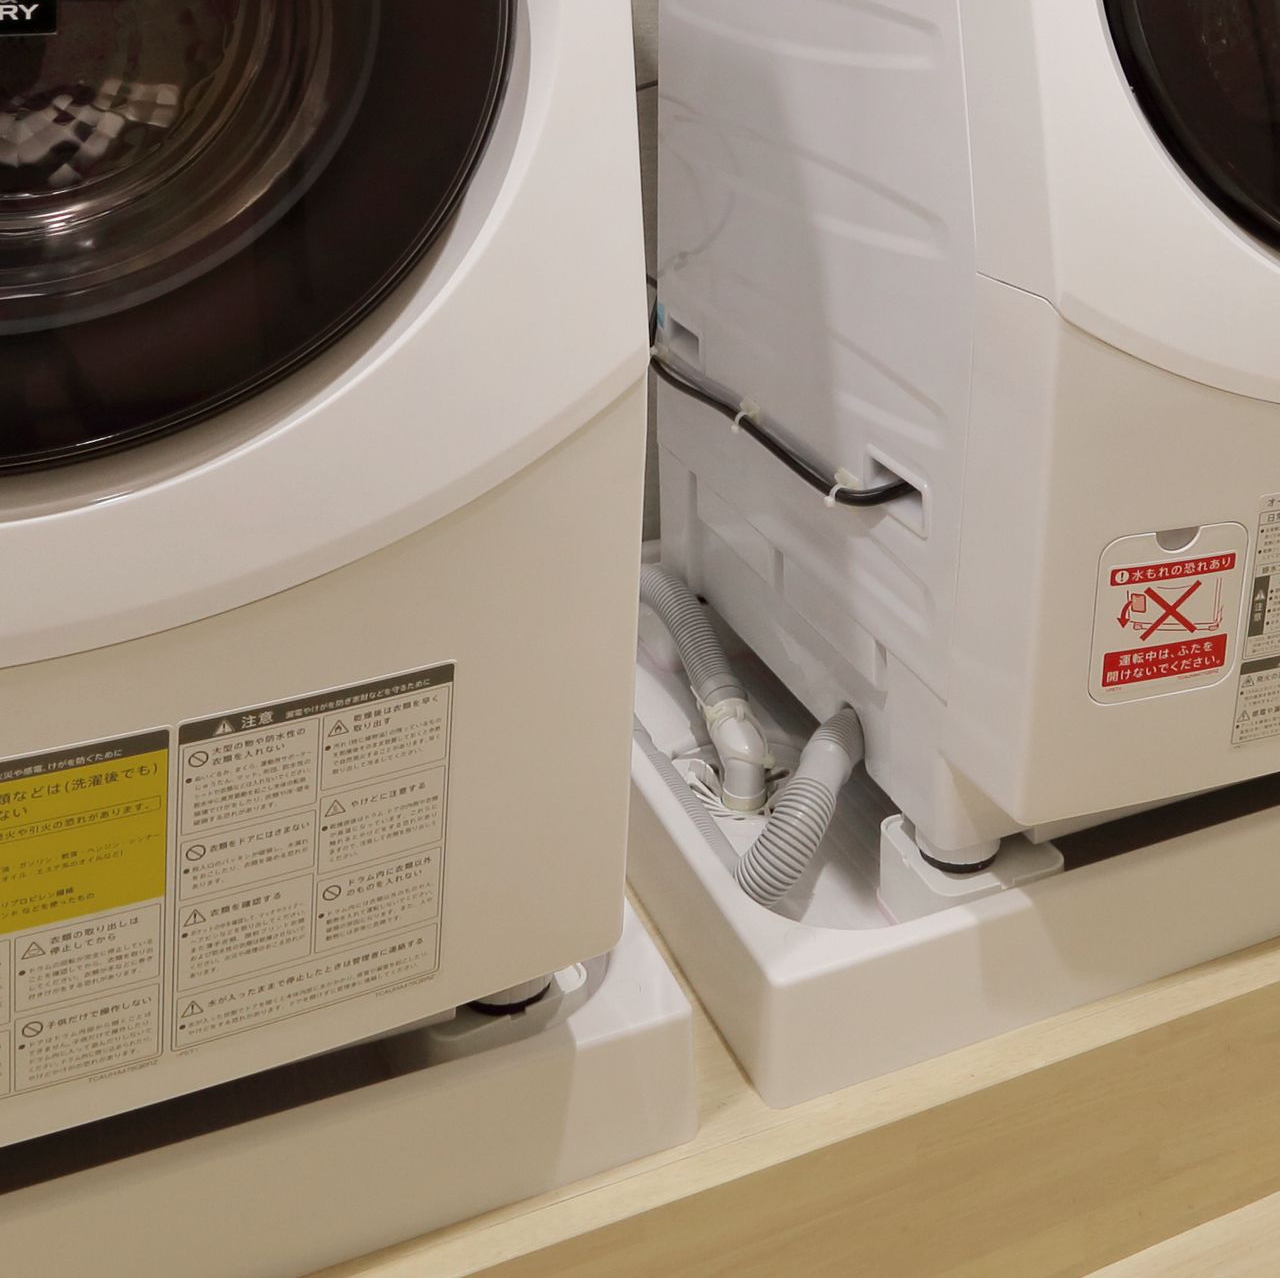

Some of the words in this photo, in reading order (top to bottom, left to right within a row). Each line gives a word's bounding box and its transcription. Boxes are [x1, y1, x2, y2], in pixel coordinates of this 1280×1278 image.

[1132, 558, 1231, 581] 水もれの恐れあり
[1118, 642, 1213, 666] 運転中は、ふたを
[1106, 656, 1220, 683] 開けないでください。
[241, 711, 275, 729] 注意
[50, 917, 139, 944] 衣類の取り出しは
[50, 933, 116, 955] 停止してから
